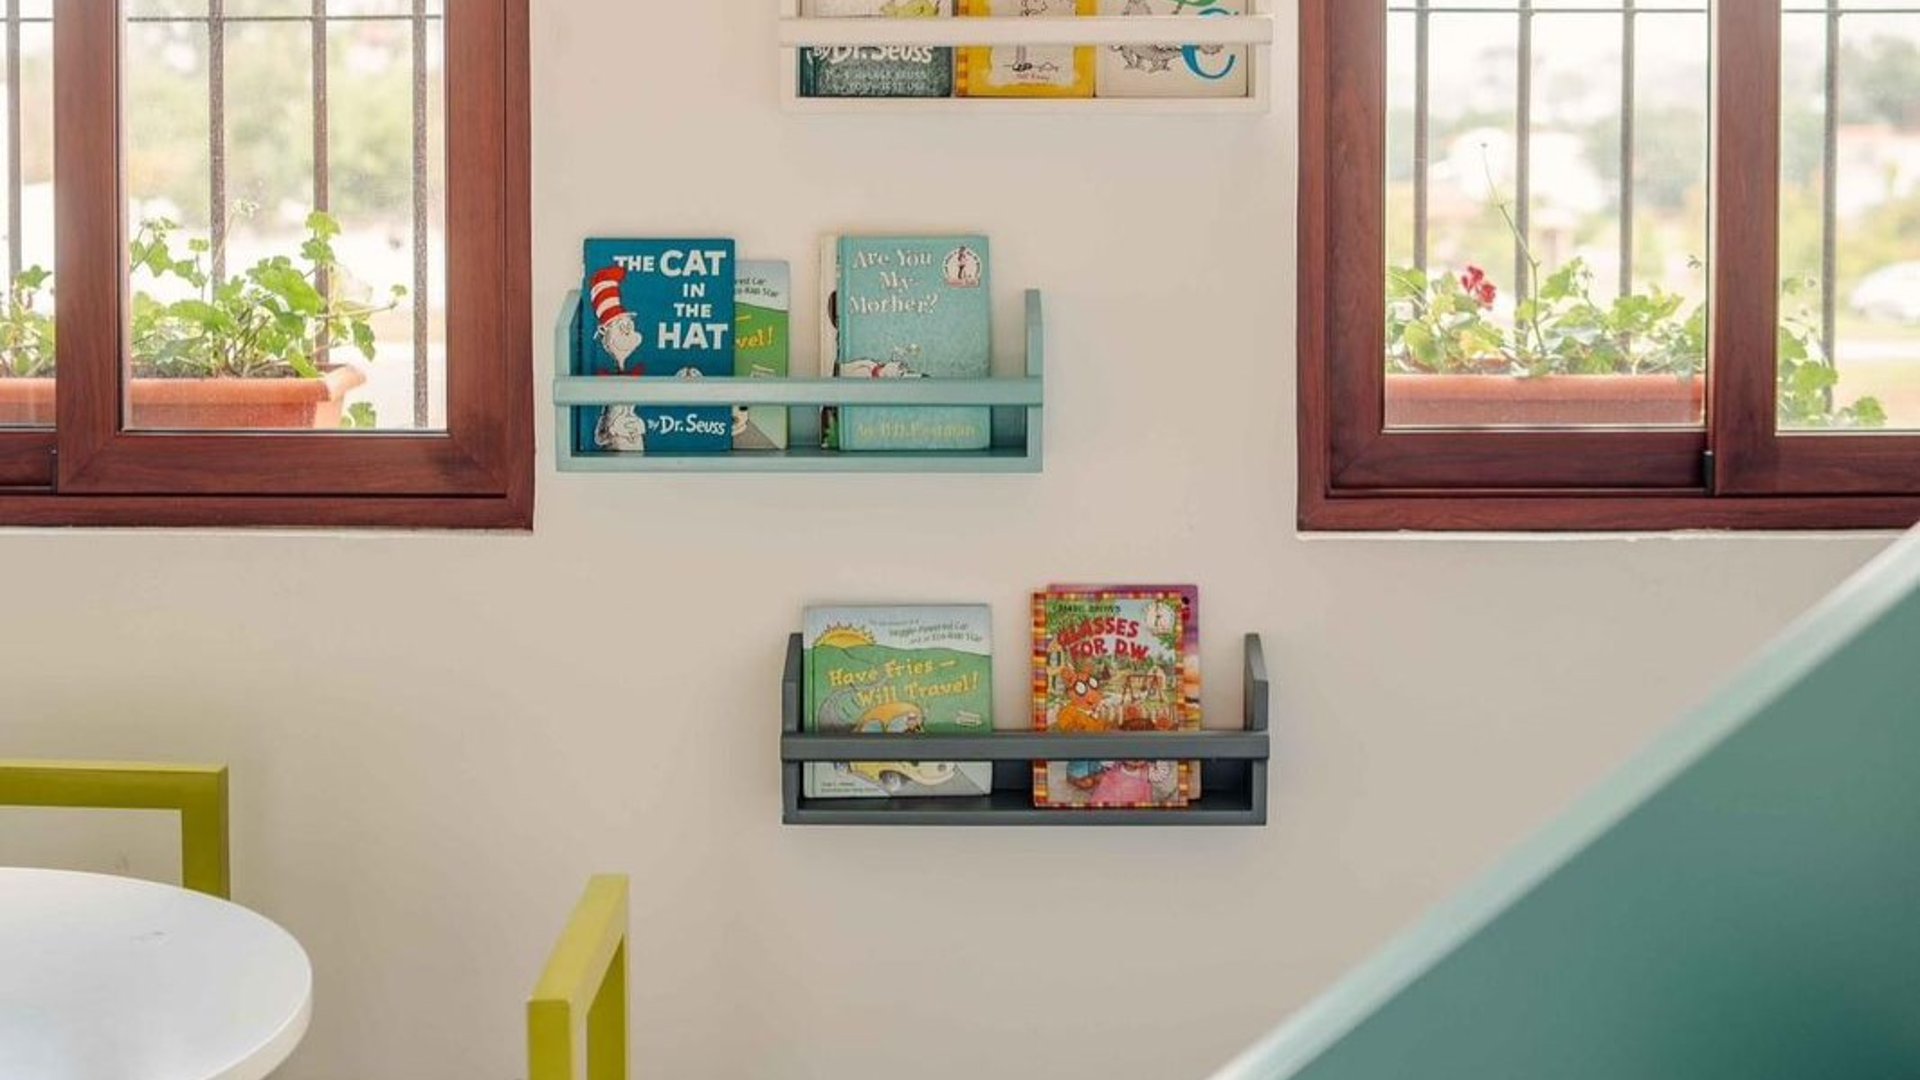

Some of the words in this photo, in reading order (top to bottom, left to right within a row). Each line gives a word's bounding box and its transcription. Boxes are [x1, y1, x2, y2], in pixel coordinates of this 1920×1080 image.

[871, 46, 934, 64] Seuss
[613, 255, 654, 272] THE
[659, 249, 727, 277] CAT
[852, 251, 890, 269] Are
[896, 249, 933, 267] You
[682, 283, 706, 298] IN
[880, 271, 916, 293] My
[673, 303, 712, 318] THE
[849, 293, 939, 314] Mother?
[657, 322, 729, 350] HAT
[736, 326, 773, 350] vel!
[659, 415, 684, 435] Dr.
[686, 413, 727, 436] Seuss
[1057, 616, 1140, 647] GLASSES
[1070, 637, 1108, 660] FOR
[829, 667, 878, 686] Have
[884, 658, 934, 679] Fries
[856, 685, 897, 709] Will
[903, 671, 981, 700] Travel!
